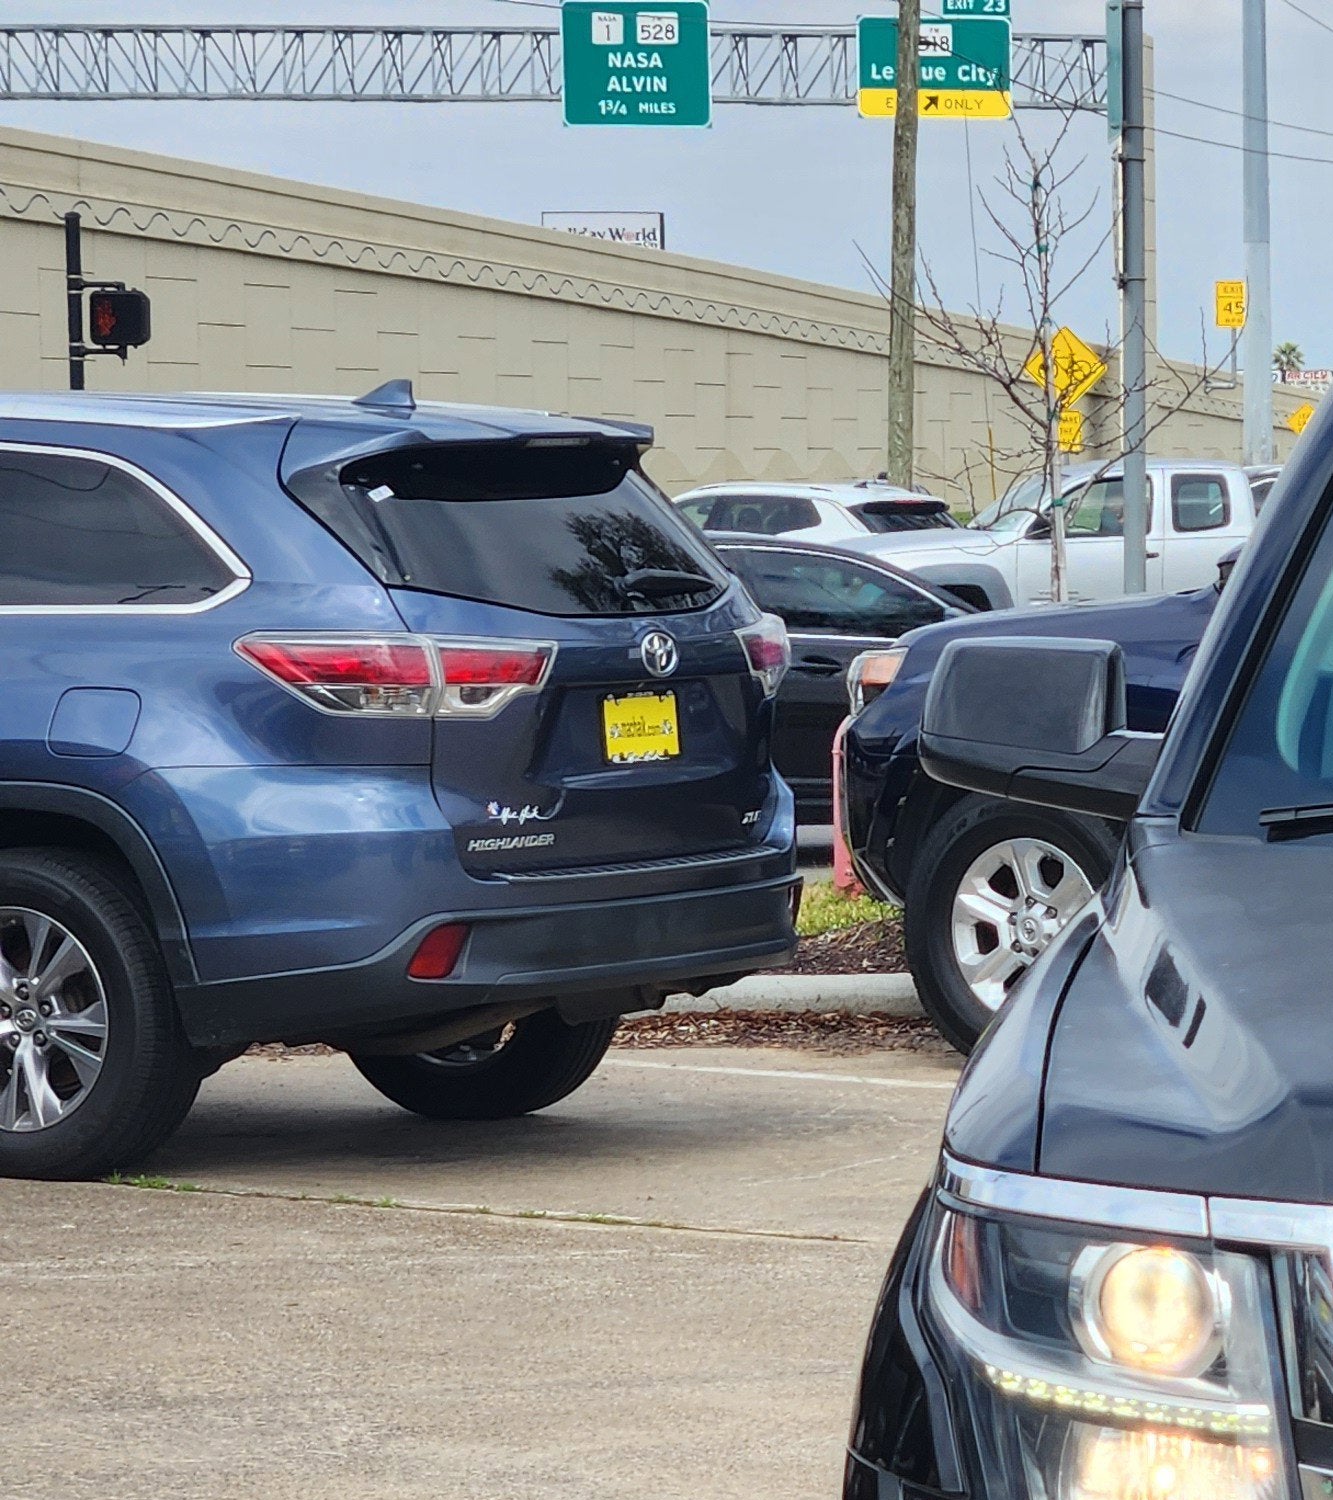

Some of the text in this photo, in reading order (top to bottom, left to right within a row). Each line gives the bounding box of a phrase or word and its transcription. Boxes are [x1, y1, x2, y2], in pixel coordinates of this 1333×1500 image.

[946, 0, 974, 10] EXIT
[605, 24, 611, 41] 1
[640, 23, 675, 41] 528
[608, 51, 663, 69] NASA
[871, 62, 999, 86] Leue City
[607, 75, 667, 93] ALVIN
[638, 102, 676, 115] MILES
[944, 99, 984, 111] ONLY
[1223, 301, 1245, 315] 45
[466, 833, 555, 852] HIGHLANDER
